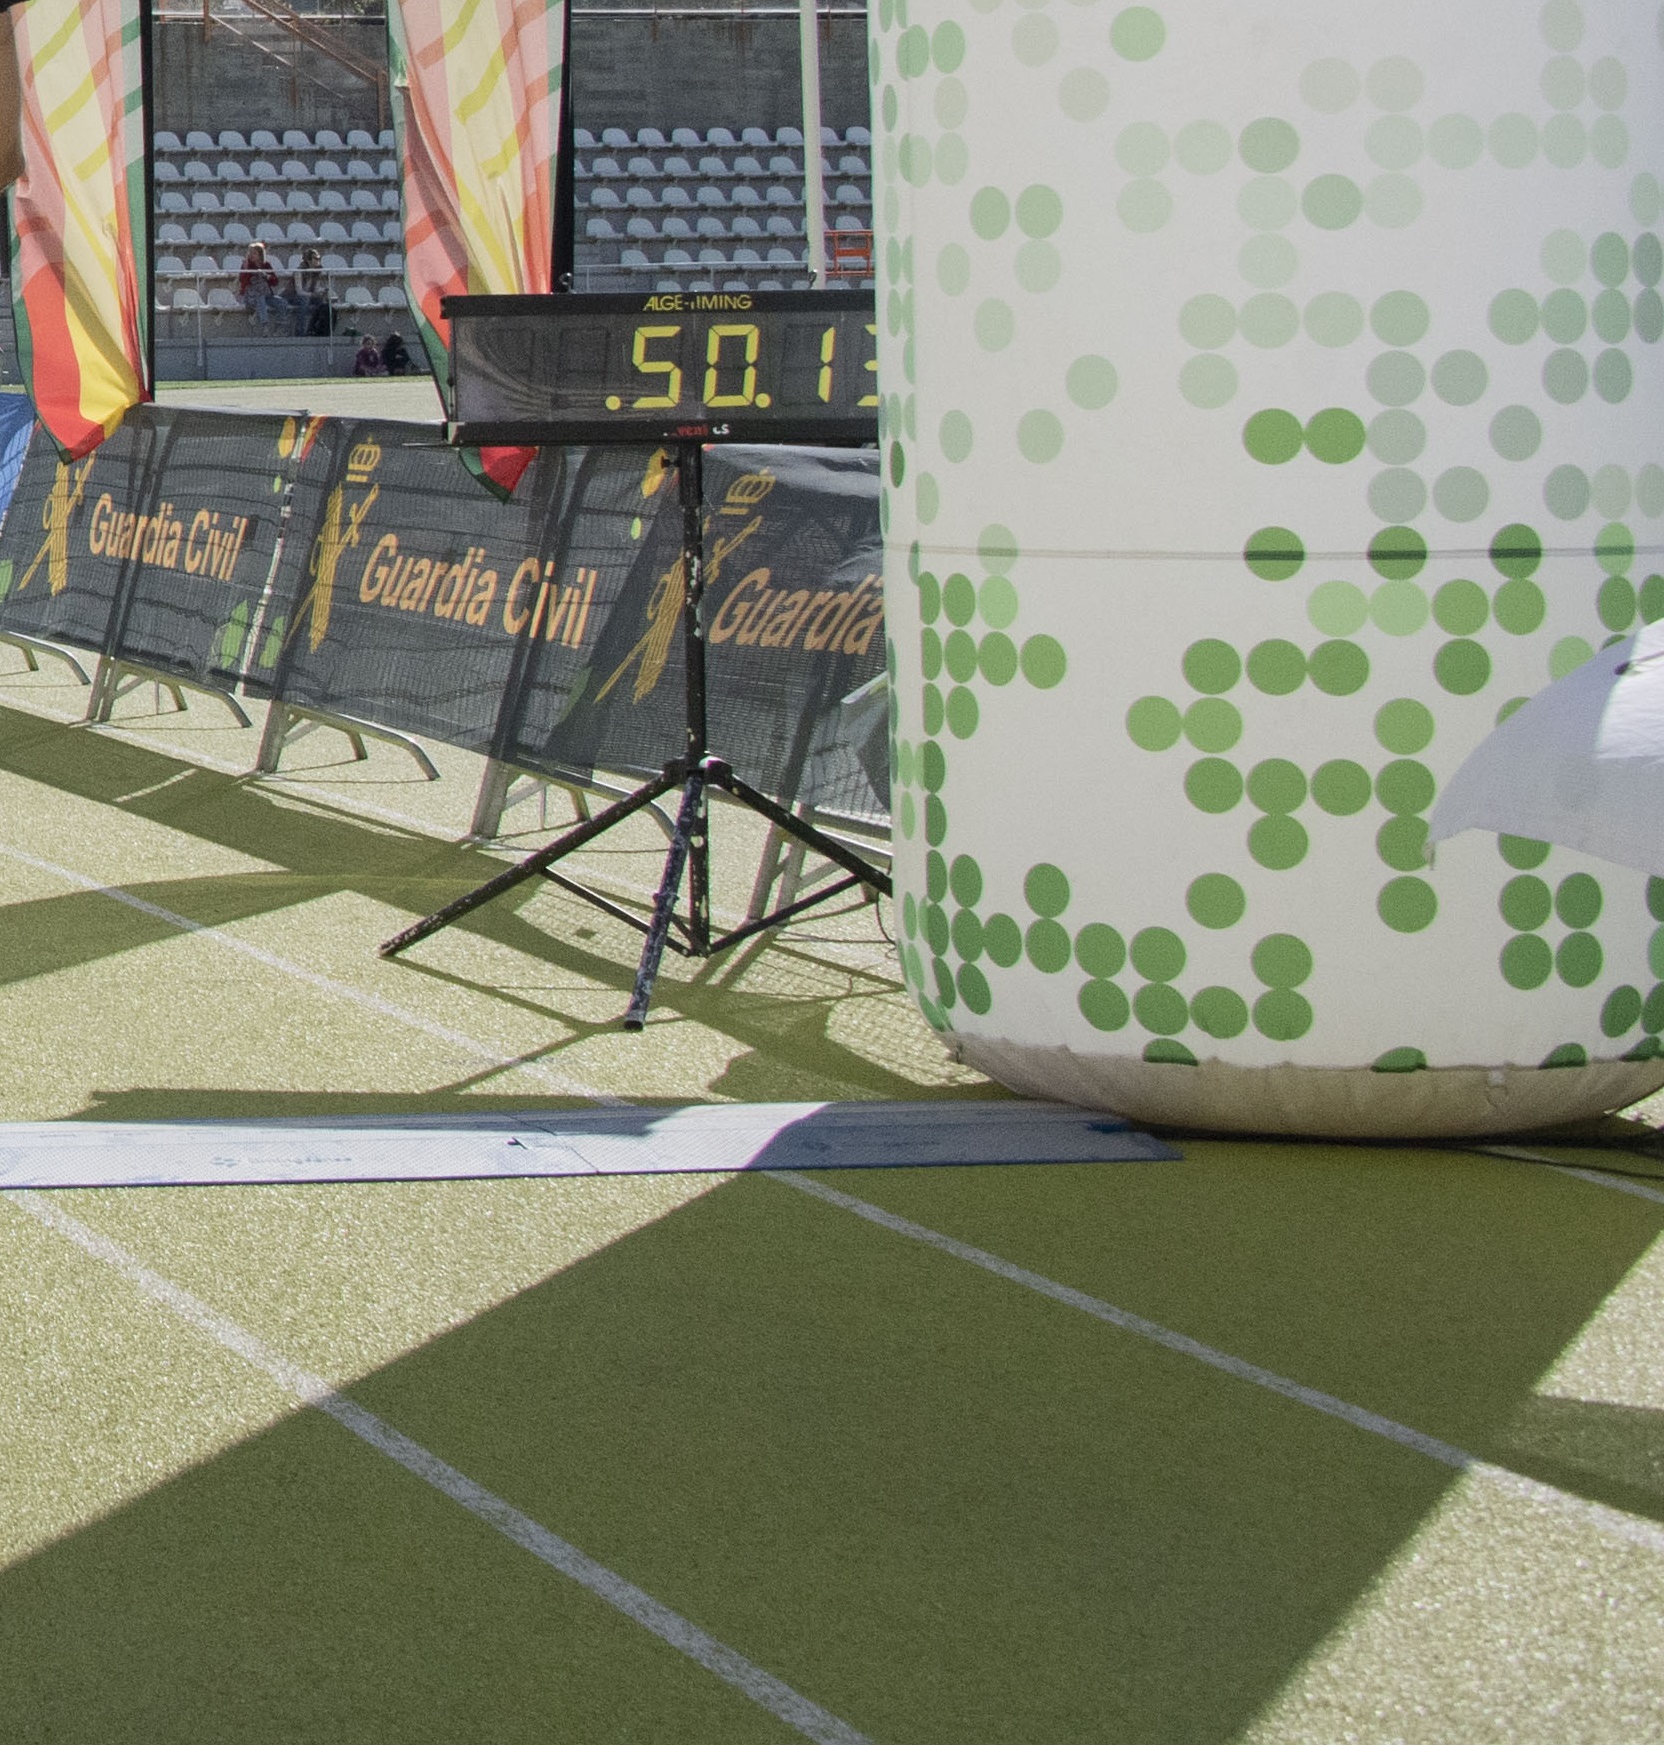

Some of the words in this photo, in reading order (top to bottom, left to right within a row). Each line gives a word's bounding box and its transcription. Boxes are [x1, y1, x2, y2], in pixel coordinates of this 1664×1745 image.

[89, 492, 182, 568] Guardia
[185, 508, 249, 582] Civil
[359, 533, 498, 626] Guardia
[503, 557, 598, 649] Civil
